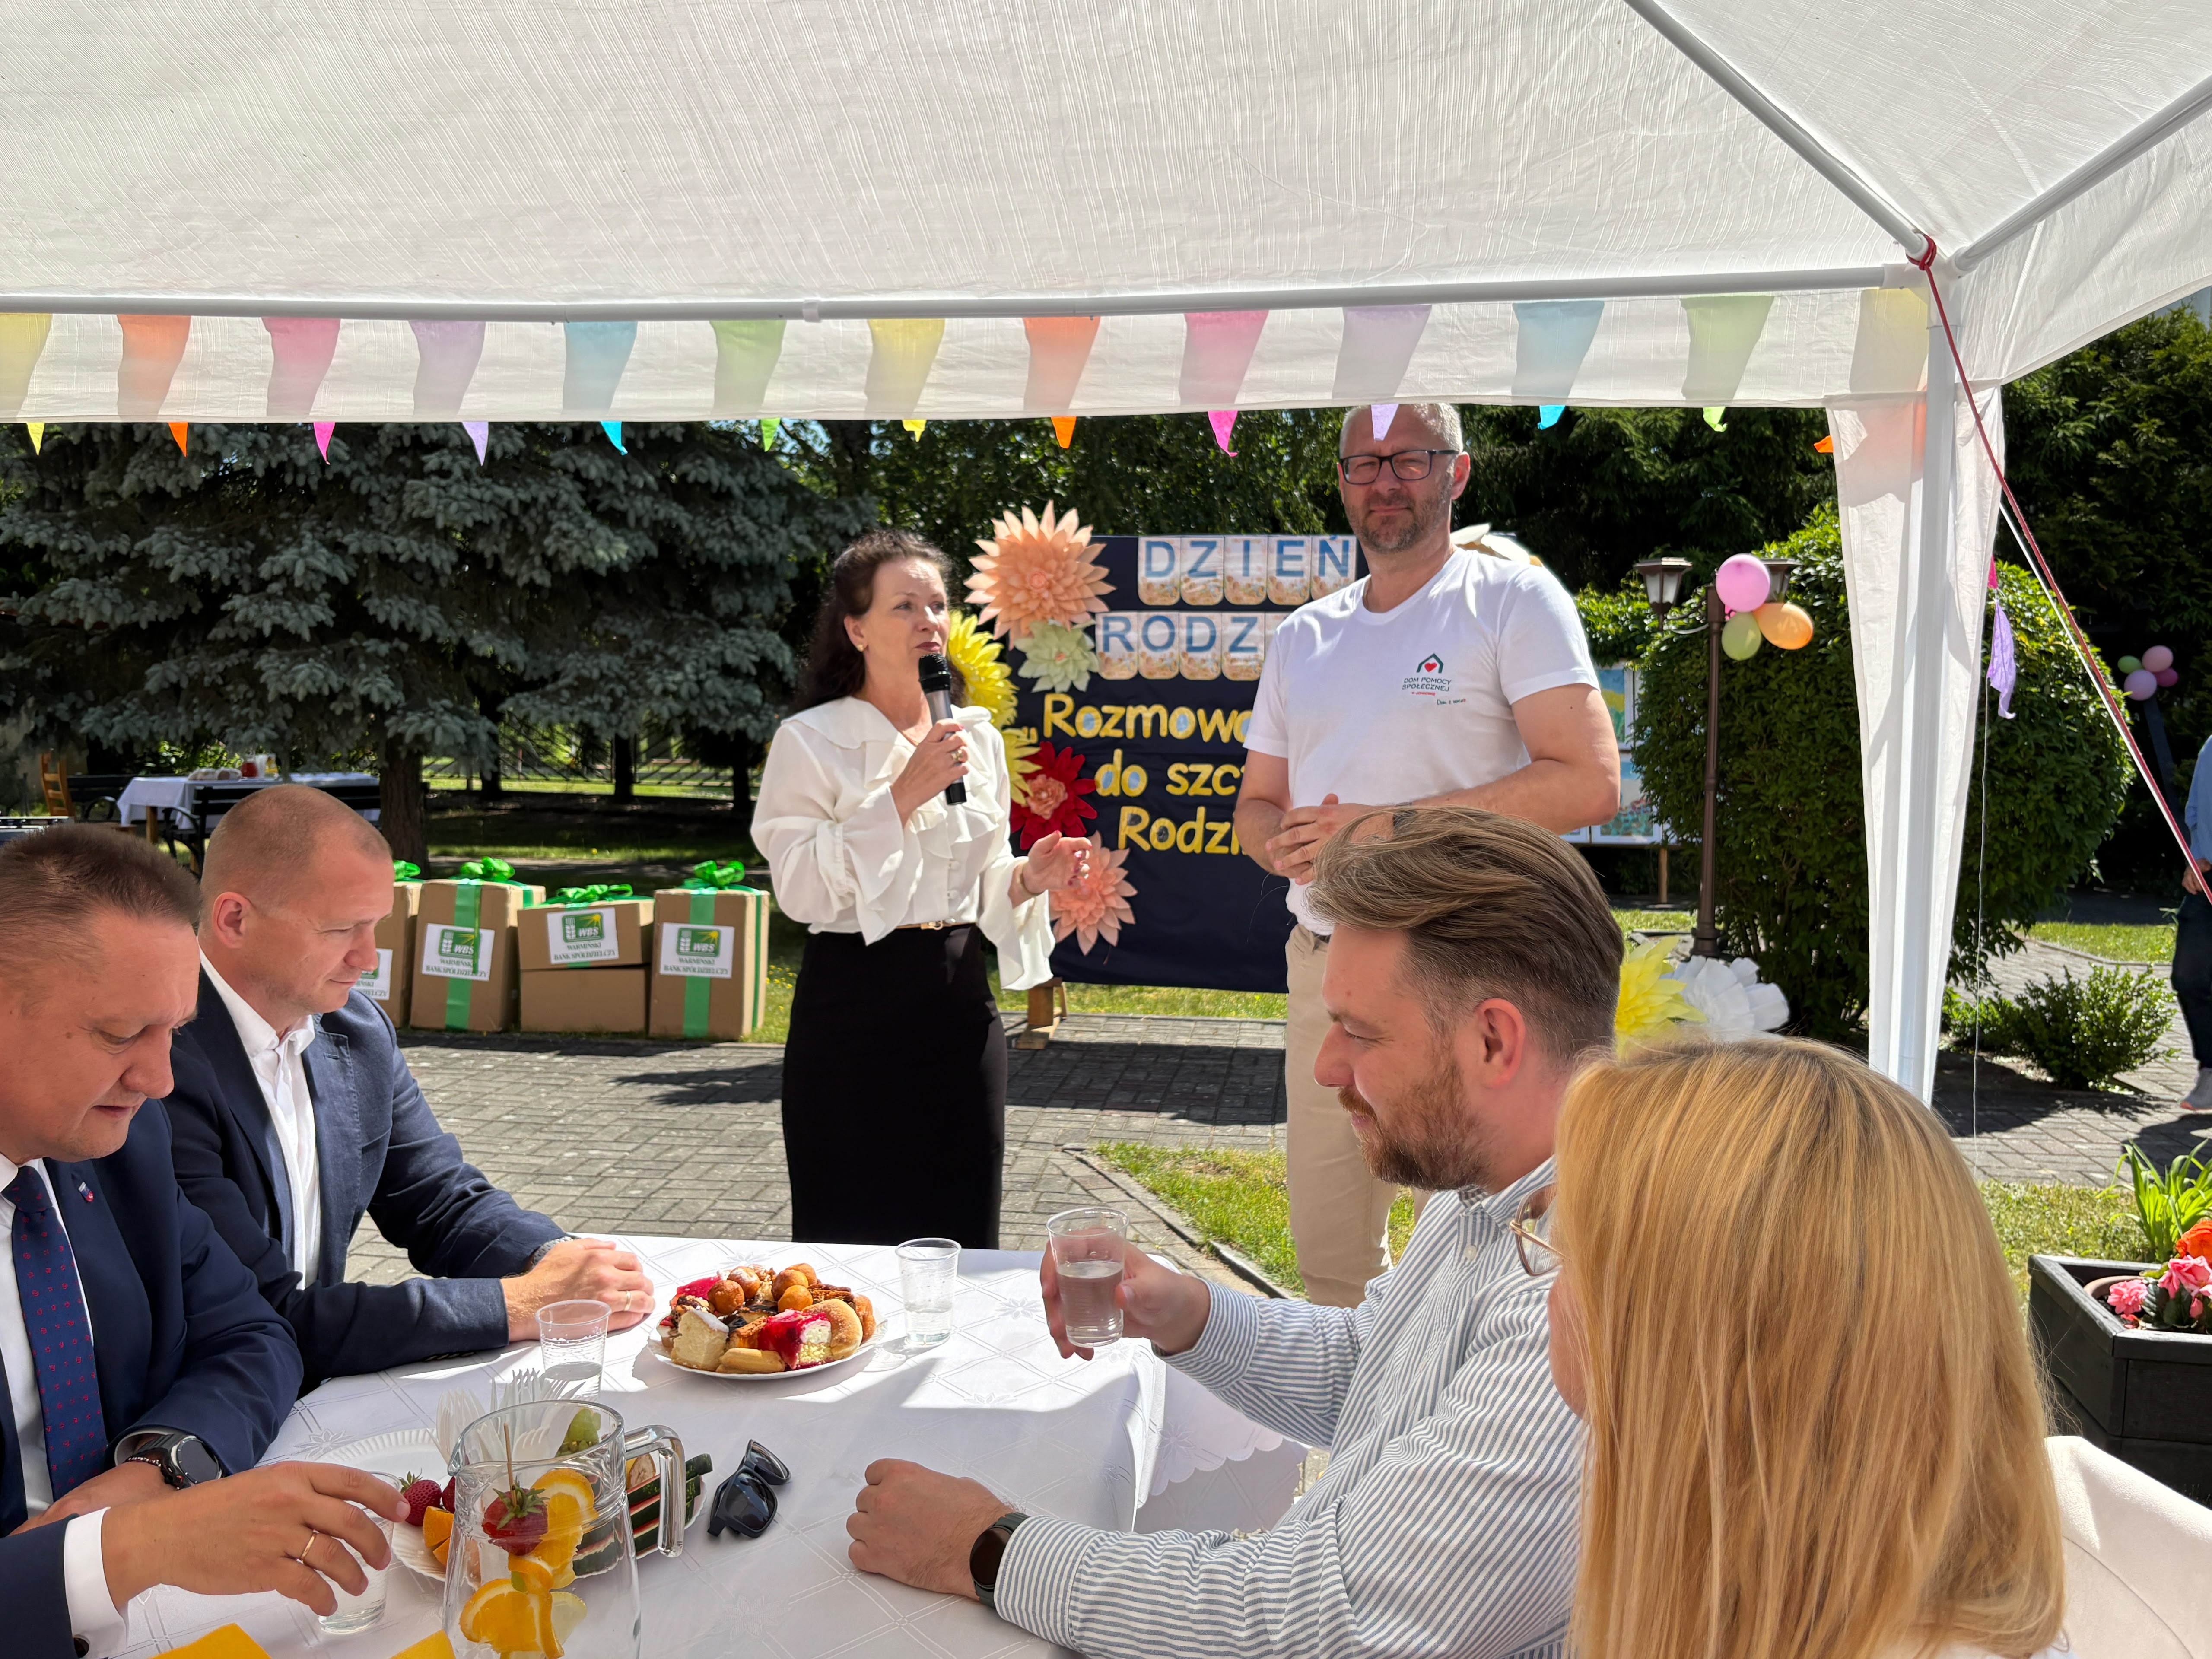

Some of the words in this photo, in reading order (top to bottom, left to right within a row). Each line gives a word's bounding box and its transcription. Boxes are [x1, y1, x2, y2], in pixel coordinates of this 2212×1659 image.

[1144, 535, 1350, 578] DZIEŃ
[1102, 616, 1259, 653] RODZ
[1094, 748, 1147, 797] do
[1166, 762, 1245, 796] szc
[1118, 806, 1248, 855] Rodzi
[454, 944, 474, 954] WBS
[578, 927, 599, 937] WBS
[693, 943, 715, 952] WBS
